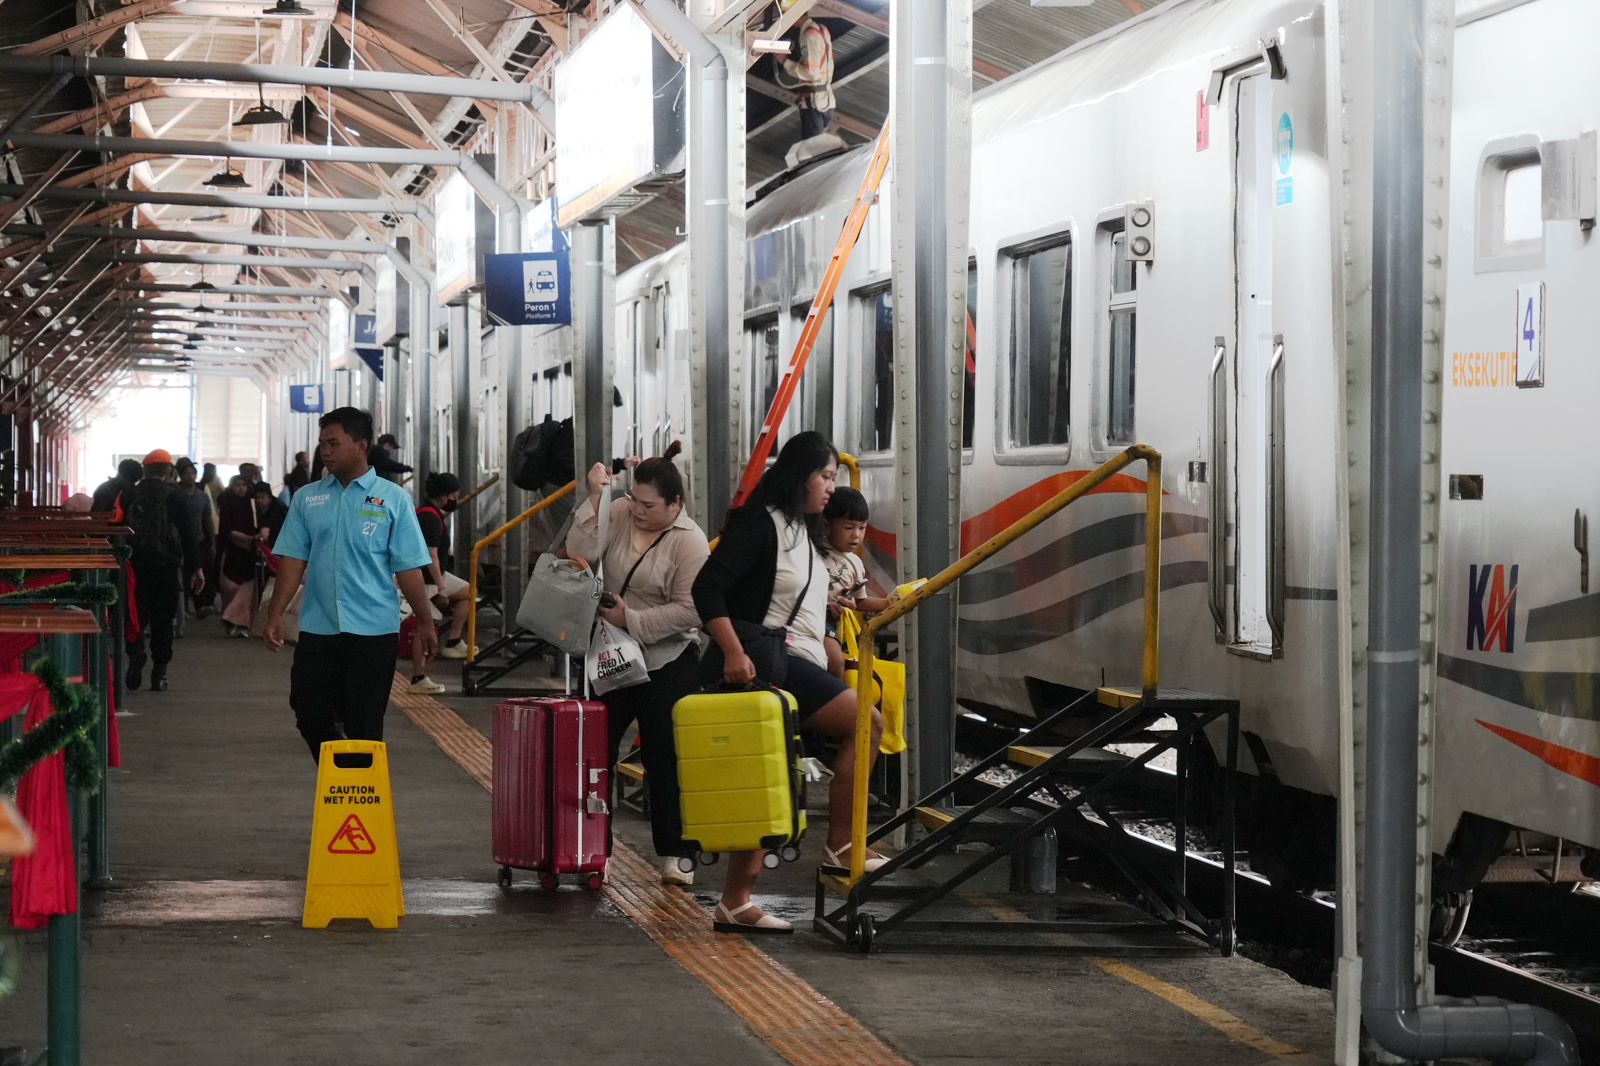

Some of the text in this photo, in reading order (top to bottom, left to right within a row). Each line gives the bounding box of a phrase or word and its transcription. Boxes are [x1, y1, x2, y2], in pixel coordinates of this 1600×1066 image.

[525, 303, 549, 311] Peron
[1523, 297, 1534, 351] 4
[362, 521, 378, 537] 27
[1467, 563, 1519, 653] KAI
[597, 658, 617, 670] FRED
[597, 661, 632, 679] CHICKEN
[329, 786, 375, 794] CAUTION
[324, 796, 381, 804] WET FLOOR
